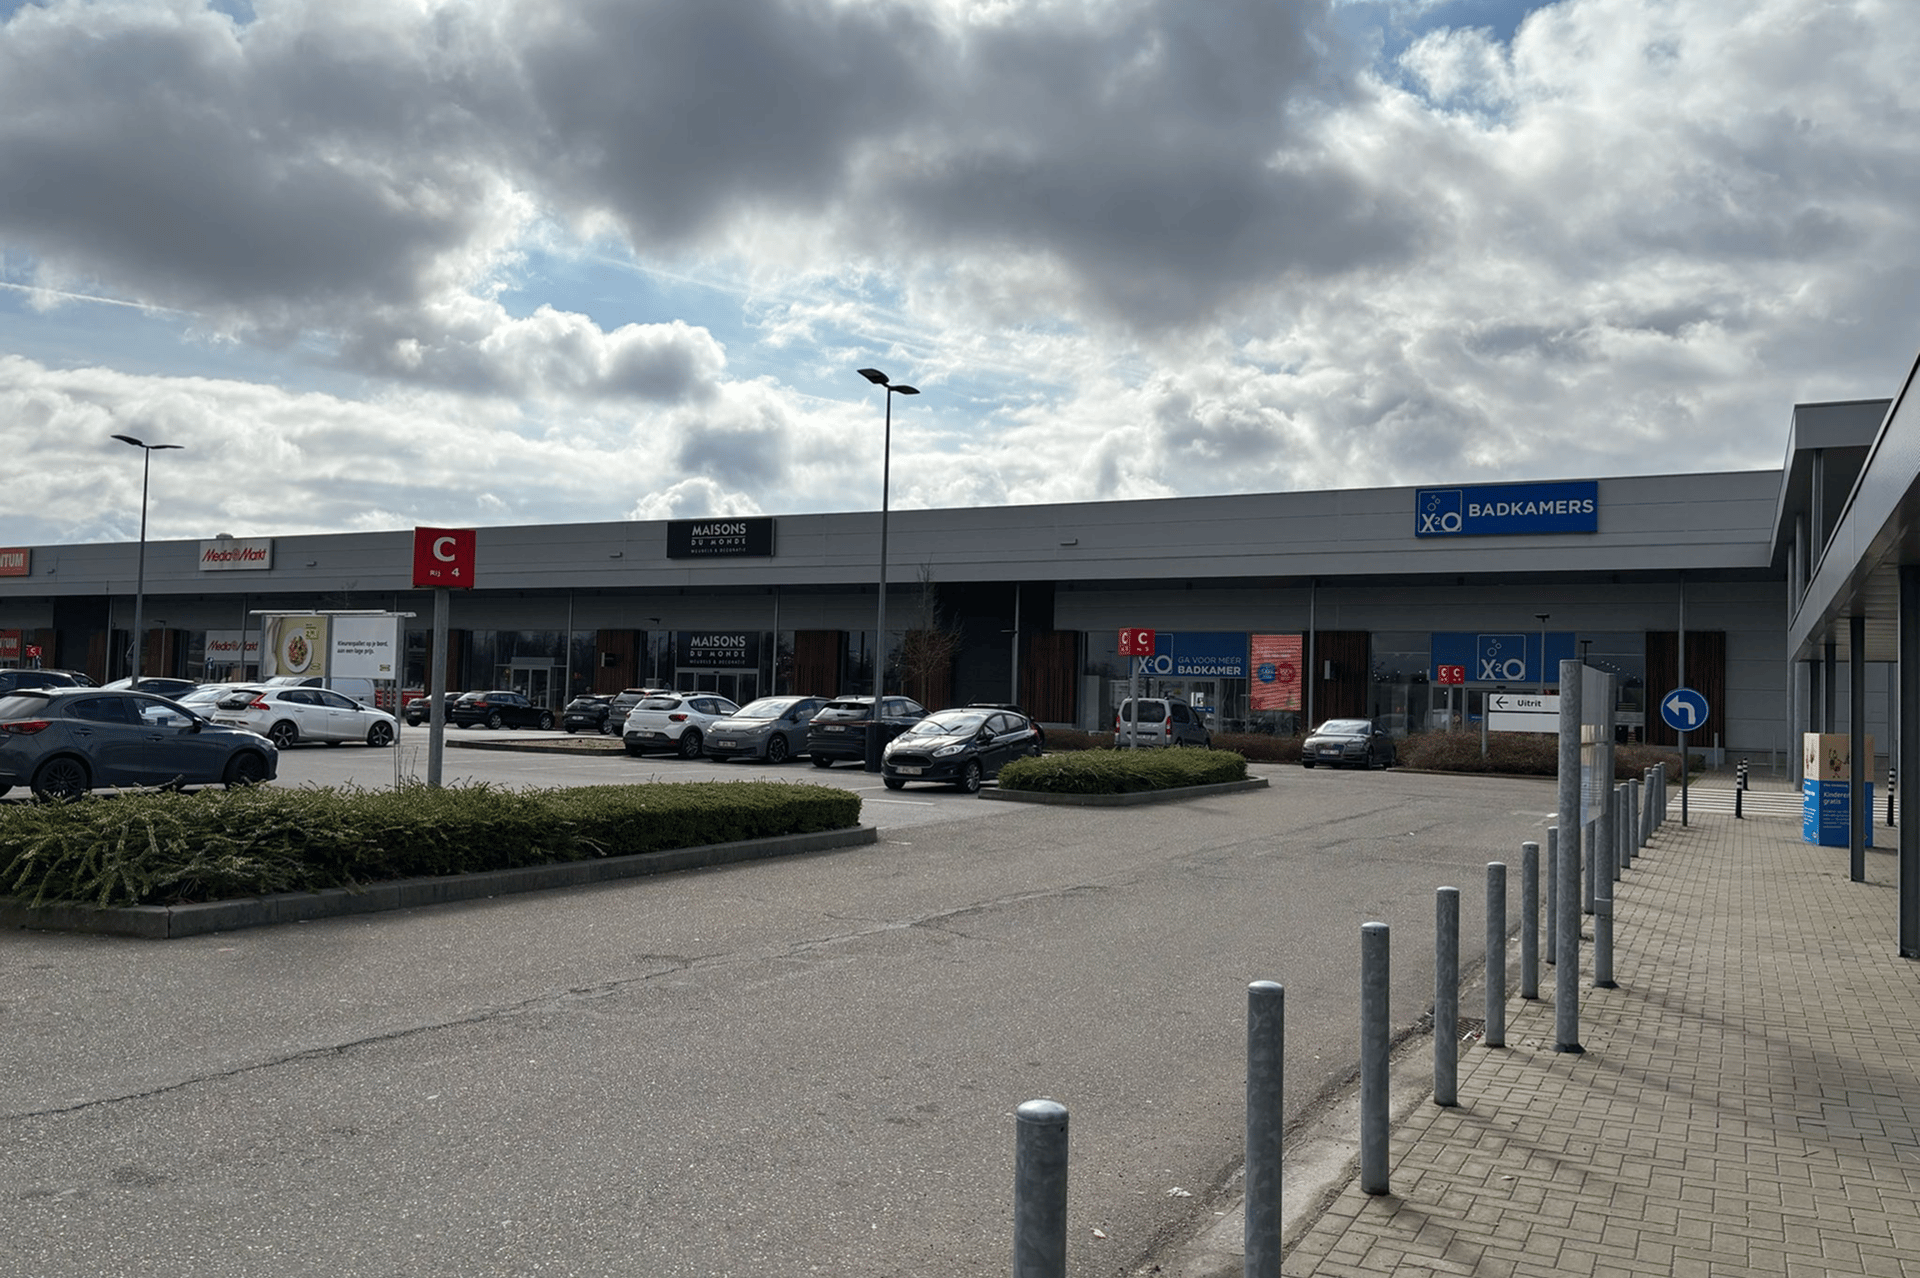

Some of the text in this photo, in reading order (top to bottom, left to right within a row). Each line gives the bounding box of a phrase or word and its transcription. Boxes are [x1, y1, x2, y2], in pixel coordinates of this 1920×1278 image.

[1468, 499, 1595, 518] BADKAMERS
[691, 523, 747, 536] MAISONS
[433, 536, 456, 562] C
[451, 567, 460, 577] 4
[690, 636, 746, 647] MAISONS
[1121, 632, 1148, 645] C C
[690, 650, 746, 658] DU MONDE
[1177, 666, 1242, 675] BADKAMER
[1453, 668, 1460, 677] C
[1517, 700, 1542, 708] Uitrit
